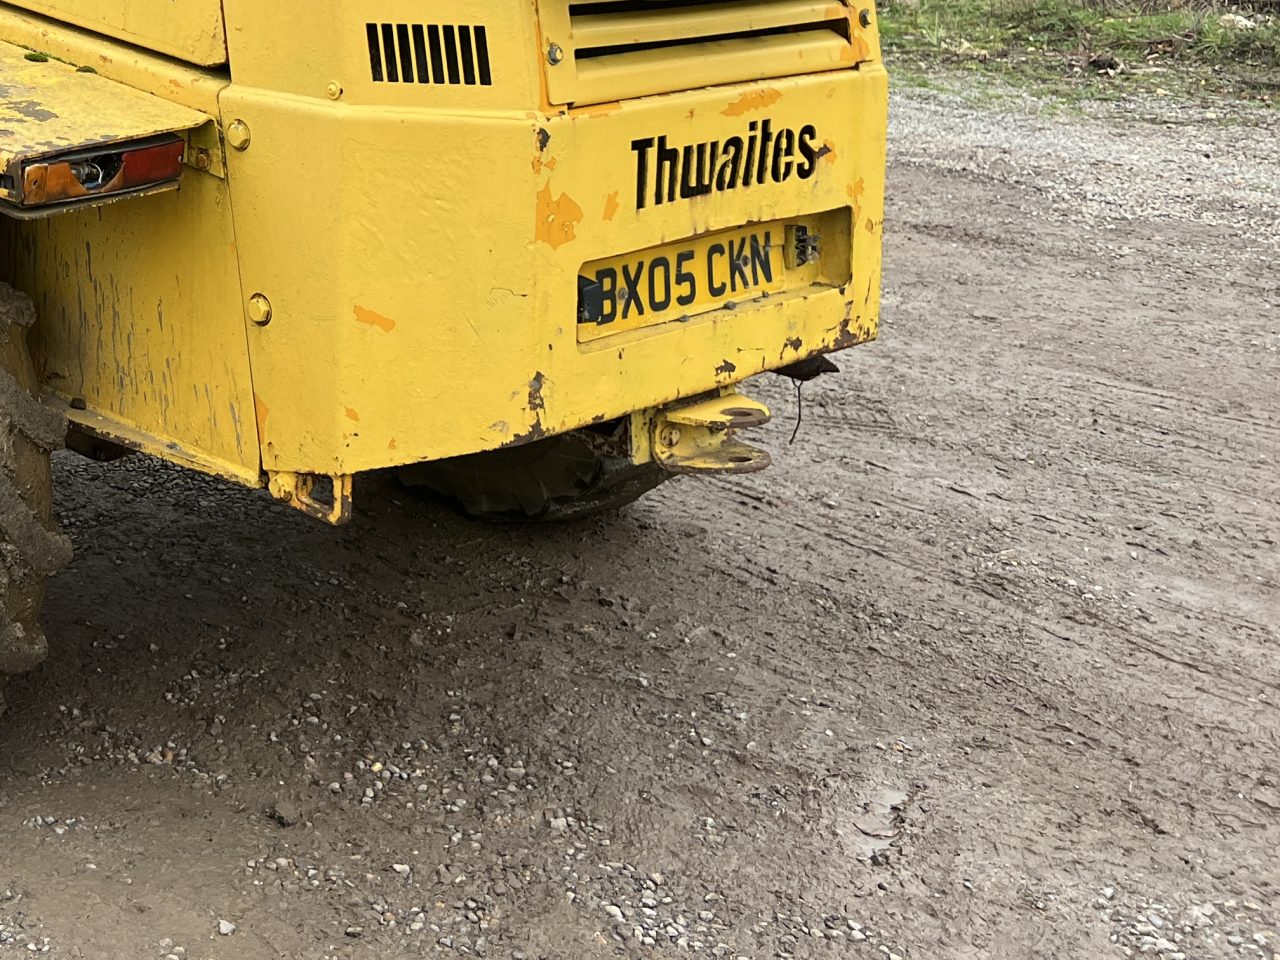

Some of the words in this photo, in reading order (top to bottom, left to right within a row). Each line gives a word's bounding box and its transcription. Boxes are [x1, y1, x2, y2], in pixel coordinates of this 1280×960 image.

[631, 119, 817, 209] Thwaites
[595, 250, 697, 325] BX05
[707, 231, 773, 298] CKN
